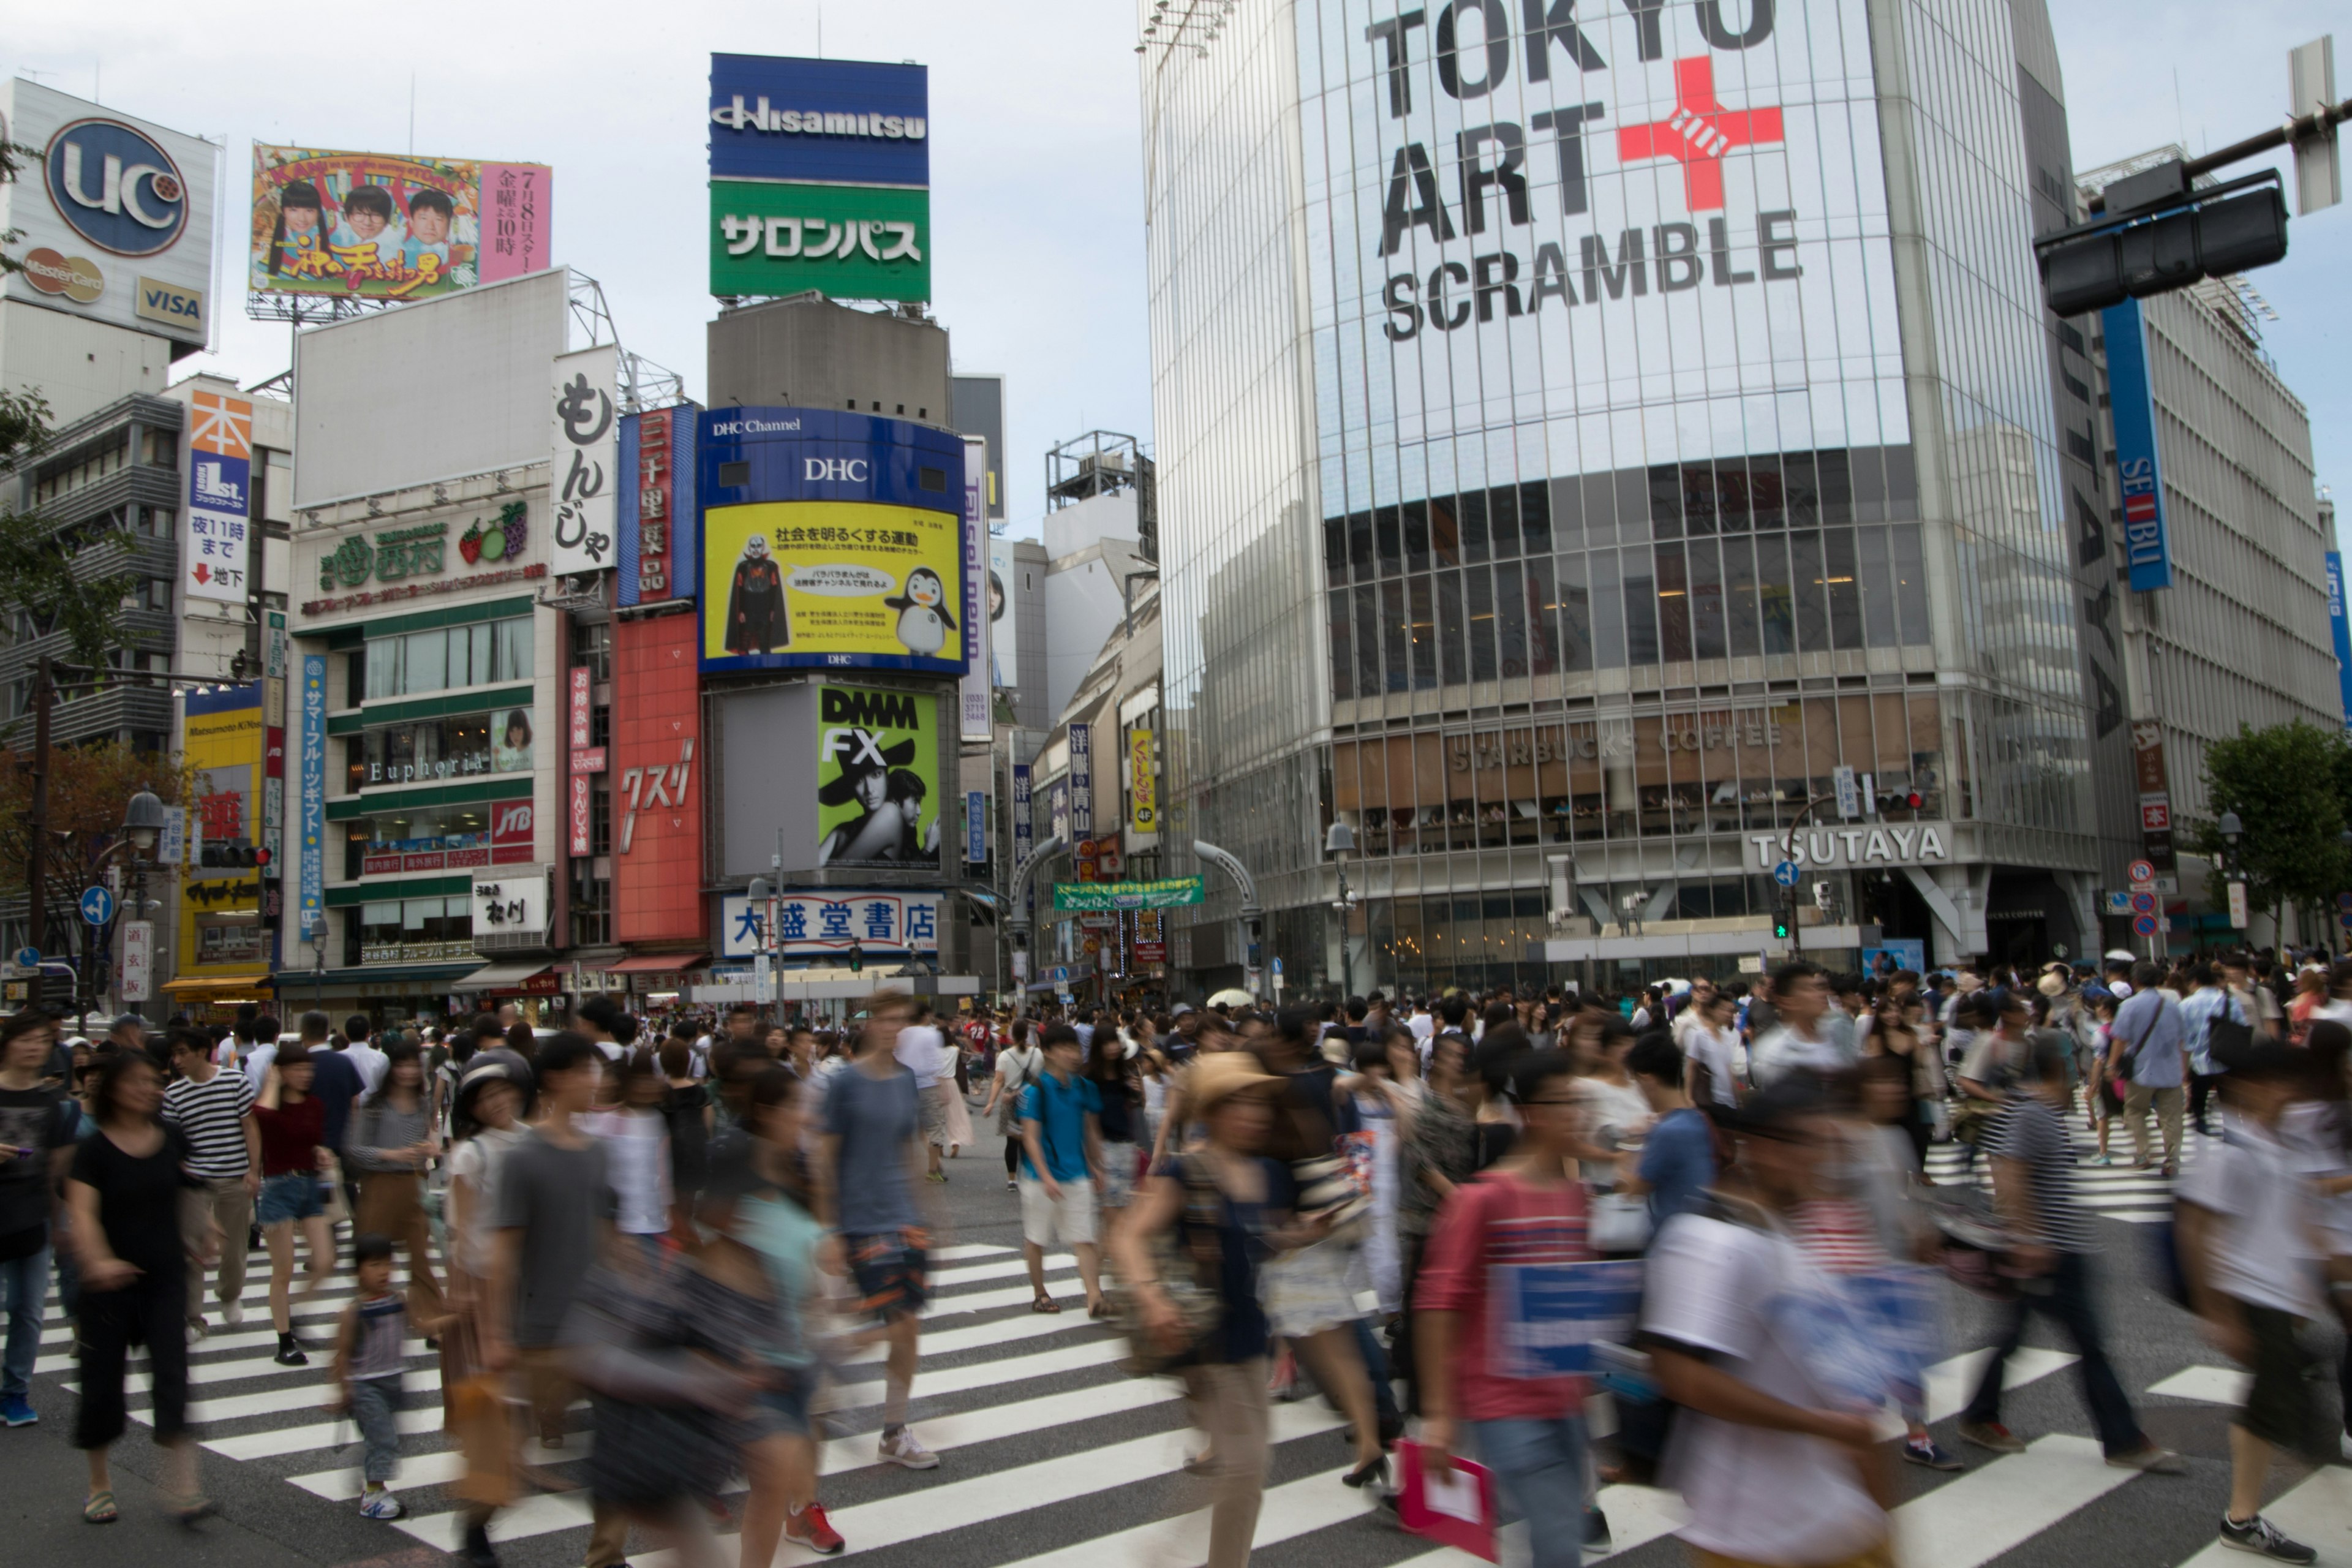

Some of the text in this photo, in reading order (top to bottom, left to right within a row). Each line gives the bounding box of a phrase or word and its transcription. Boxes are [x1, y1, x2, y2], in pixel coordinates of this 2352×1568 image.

[1365, 0, 1776, 119] TOKYO
[711, 95, 926, 139] Hisamitsu
[64, 140, 183, 228] UC
[1378, 101, 1605, 258] ART
[520, 172, 535, 275] 7月8日スター
[720, 214, 921, 262] サロンパス
[27, 258, 103, 290] MasterCard
[1382, 208, 1803, 342] SCRAMBLE
[145, 289, 200, 319] VISA
[190, 395, 252, 456] 本
[714, 418, 801, 436] DHC Channel
[556, 372, 612, 564] もんじゃ
[805, 458, 868, 482] DHC
[195, 494, 244, 510] ブックファースト
[640, 415, 666, 592] 三千里薬品
[192, 516, 244, 541] 夜11時
[776, 527, 918, 546] 社会を明るくする運動
[202, 538, 234, 559] まで
[375, 537, 447, 581] 西村
[213, 567, 244, 588] 地下
[967, 587, 979, 659] neon
[827, 655, 851, 665] DHC
[573, 671, 589, 746] お好み焼
[821, 688, 919, 731] DMM
[965, 693, 984, 704] (03)
[965, 704, 986, 713] 3719
[965, 713, 986, 722] 2468
[821, 727, 888, 766] FX
[1452, 733, 1638, 772] STARBUCKS
[1659, 723, 1781, 752] COFFEE
[304, 690, 322, 834] サマーフルーツギフト
[370, 752, 484, 784] Euphoria
[1071, 728, 1091, 831] 洋服の青山
[573, 777, 589, 853] もんじゃ焼
[619, 738, 695, 854] クスリ
[1137, 810, 1152, 821] 4F
[495, 805, 532, 837] JTB
[2146, 806, 2166, 826] 本
[367, 859, 399, 871] 国内旅行
[407, 856, 441, 868] 海外旅行
[1751, 827, 1946, 867] TSUTAYA
[734, 902, 935, 943] 大盛堂書店
[126, 929, 141, 993] 道玄坂
